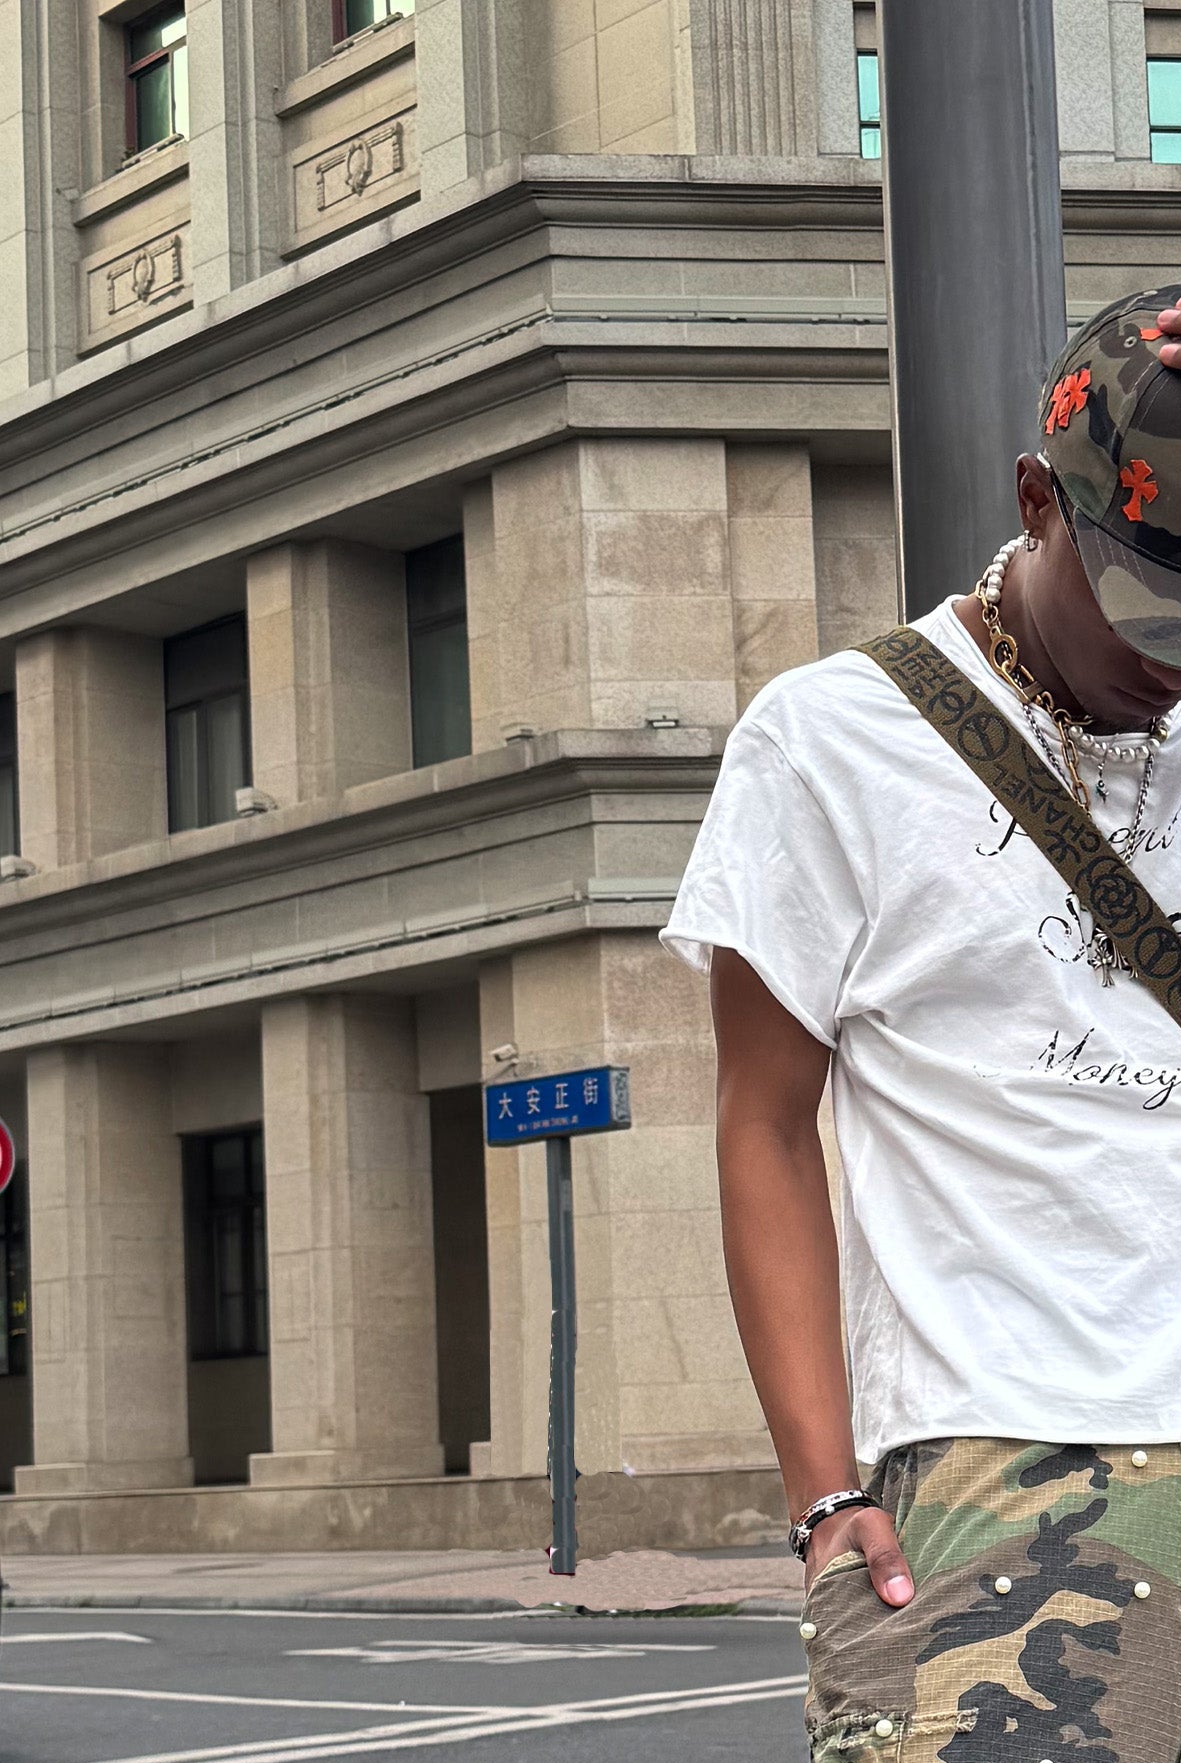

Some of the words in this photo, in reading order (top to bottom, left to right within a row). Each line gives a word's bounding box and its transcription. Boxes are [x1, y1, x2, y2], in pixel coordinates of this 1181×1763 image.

[991, 764, 1101, 852] CHANEL
[498, 1078, 598, 1119] 大安正街
